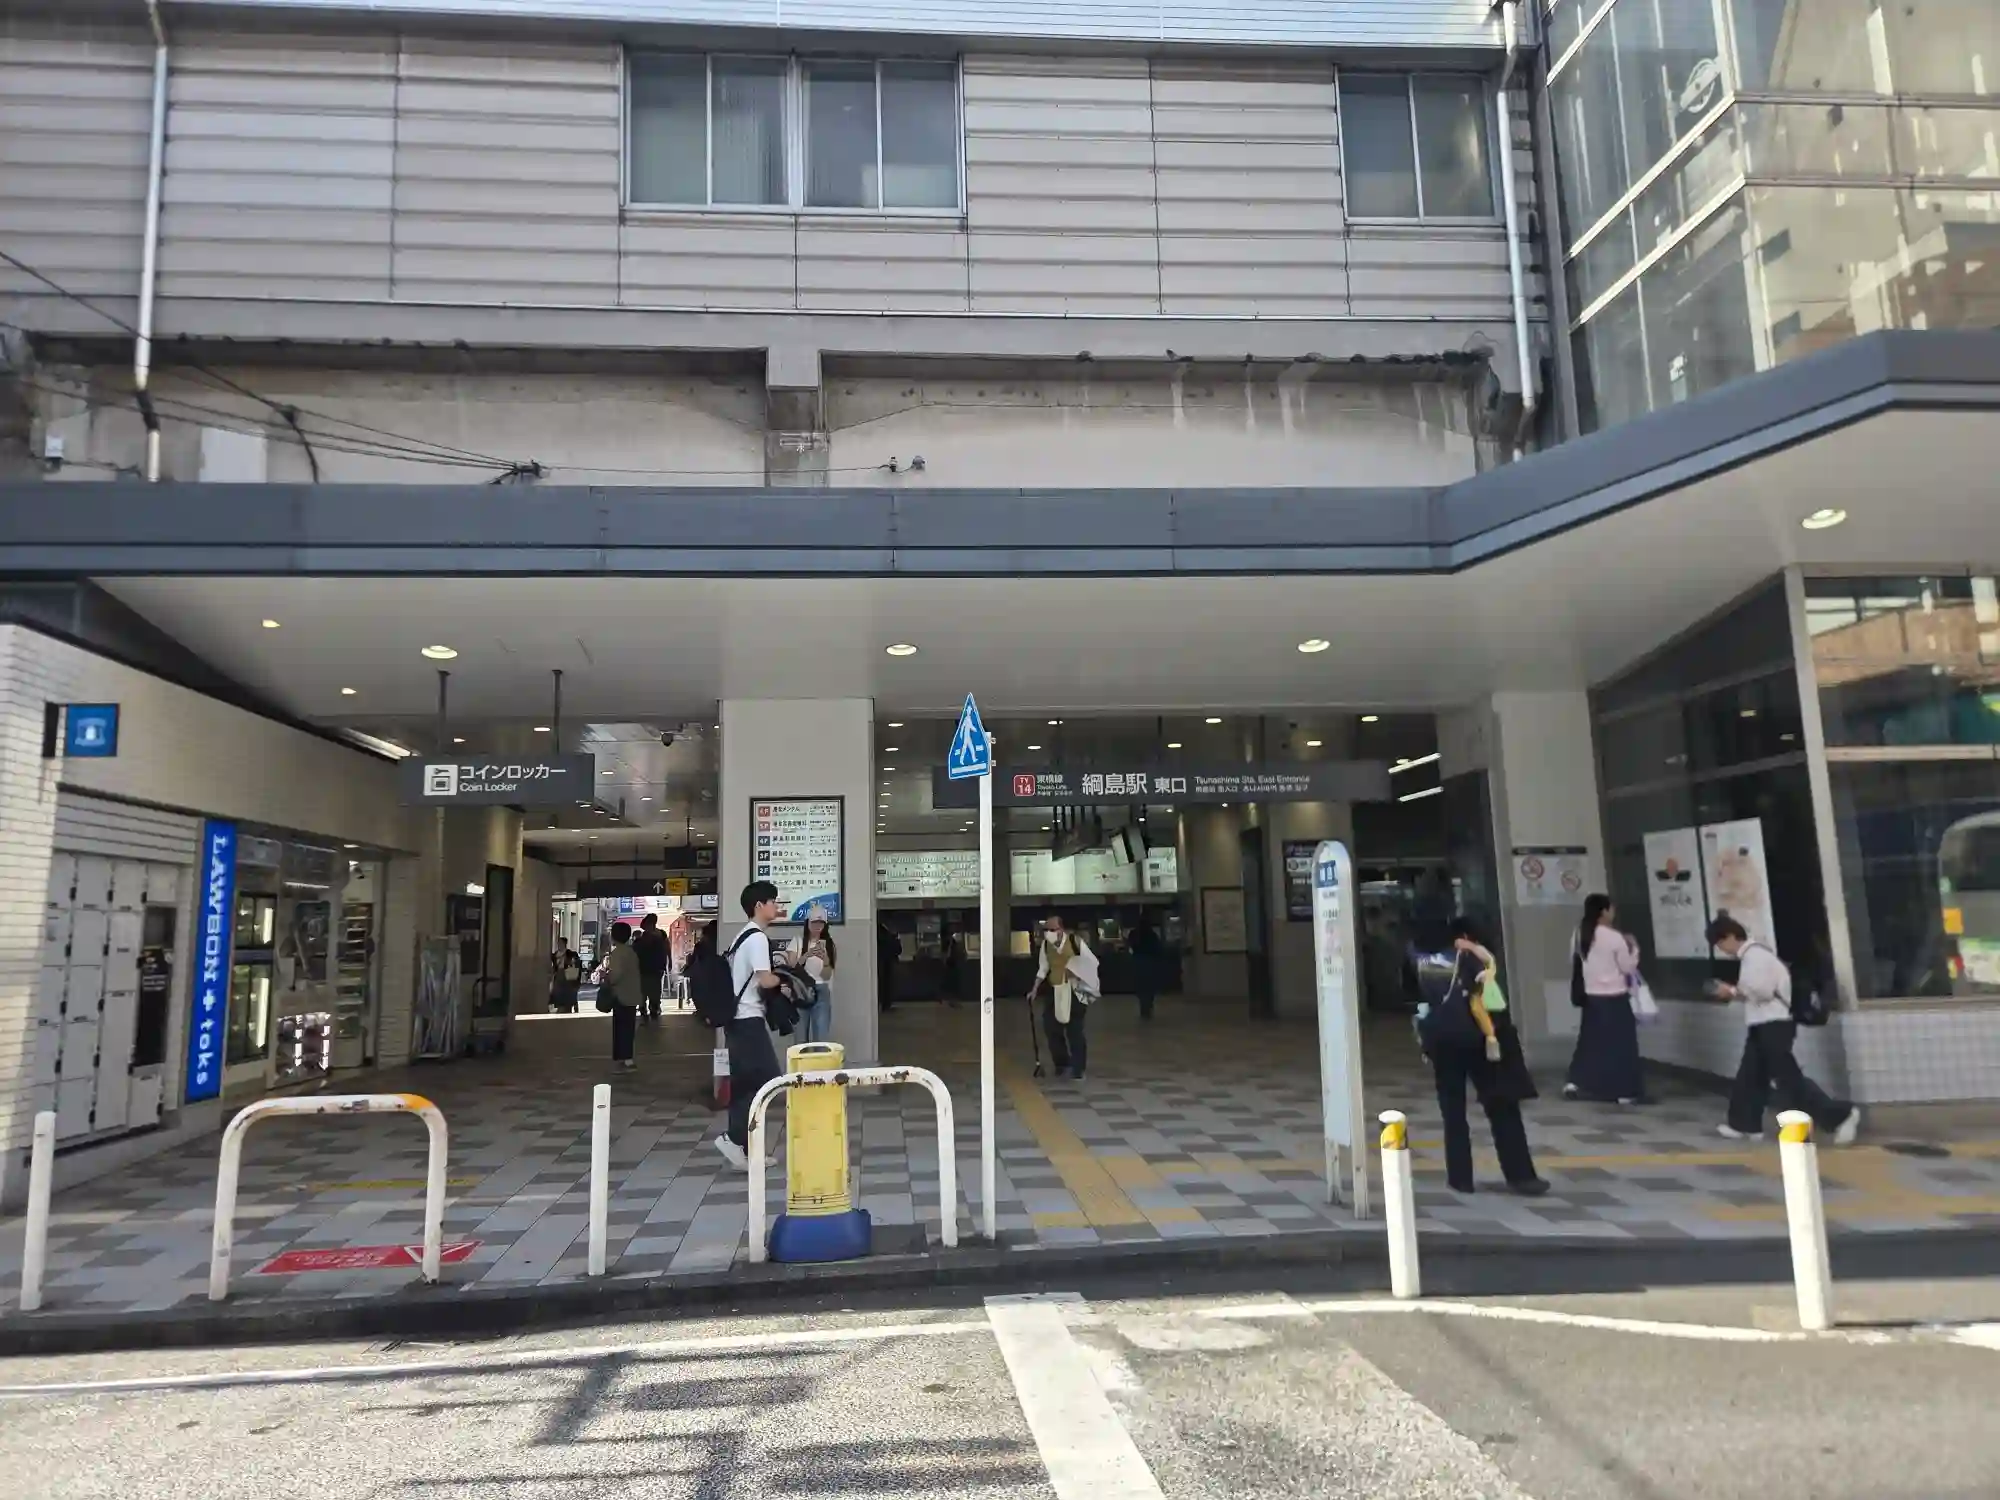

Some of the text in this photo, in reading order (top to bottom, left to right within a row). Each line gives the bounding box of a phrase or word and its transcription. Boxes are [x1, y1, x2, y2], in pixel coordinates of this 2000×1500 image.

[459, 763, 567, 780] コインロッカー
[1036, 774, 1064, 784] 東横線
[1081, 773, 1187, 795] 綱島駅 東口
[1194, 776, 1240, 785] Tsunashima
[1257, 775, 1275, 784] East
[1276, 774, 1310, 783] Entrance
[459, 782, 518, 792] Coin Locker
[1017, 784, 1032, 794] 14
[203, 834, 229, 983] LAWSON
[196, 1018, 215, 1085] toks
